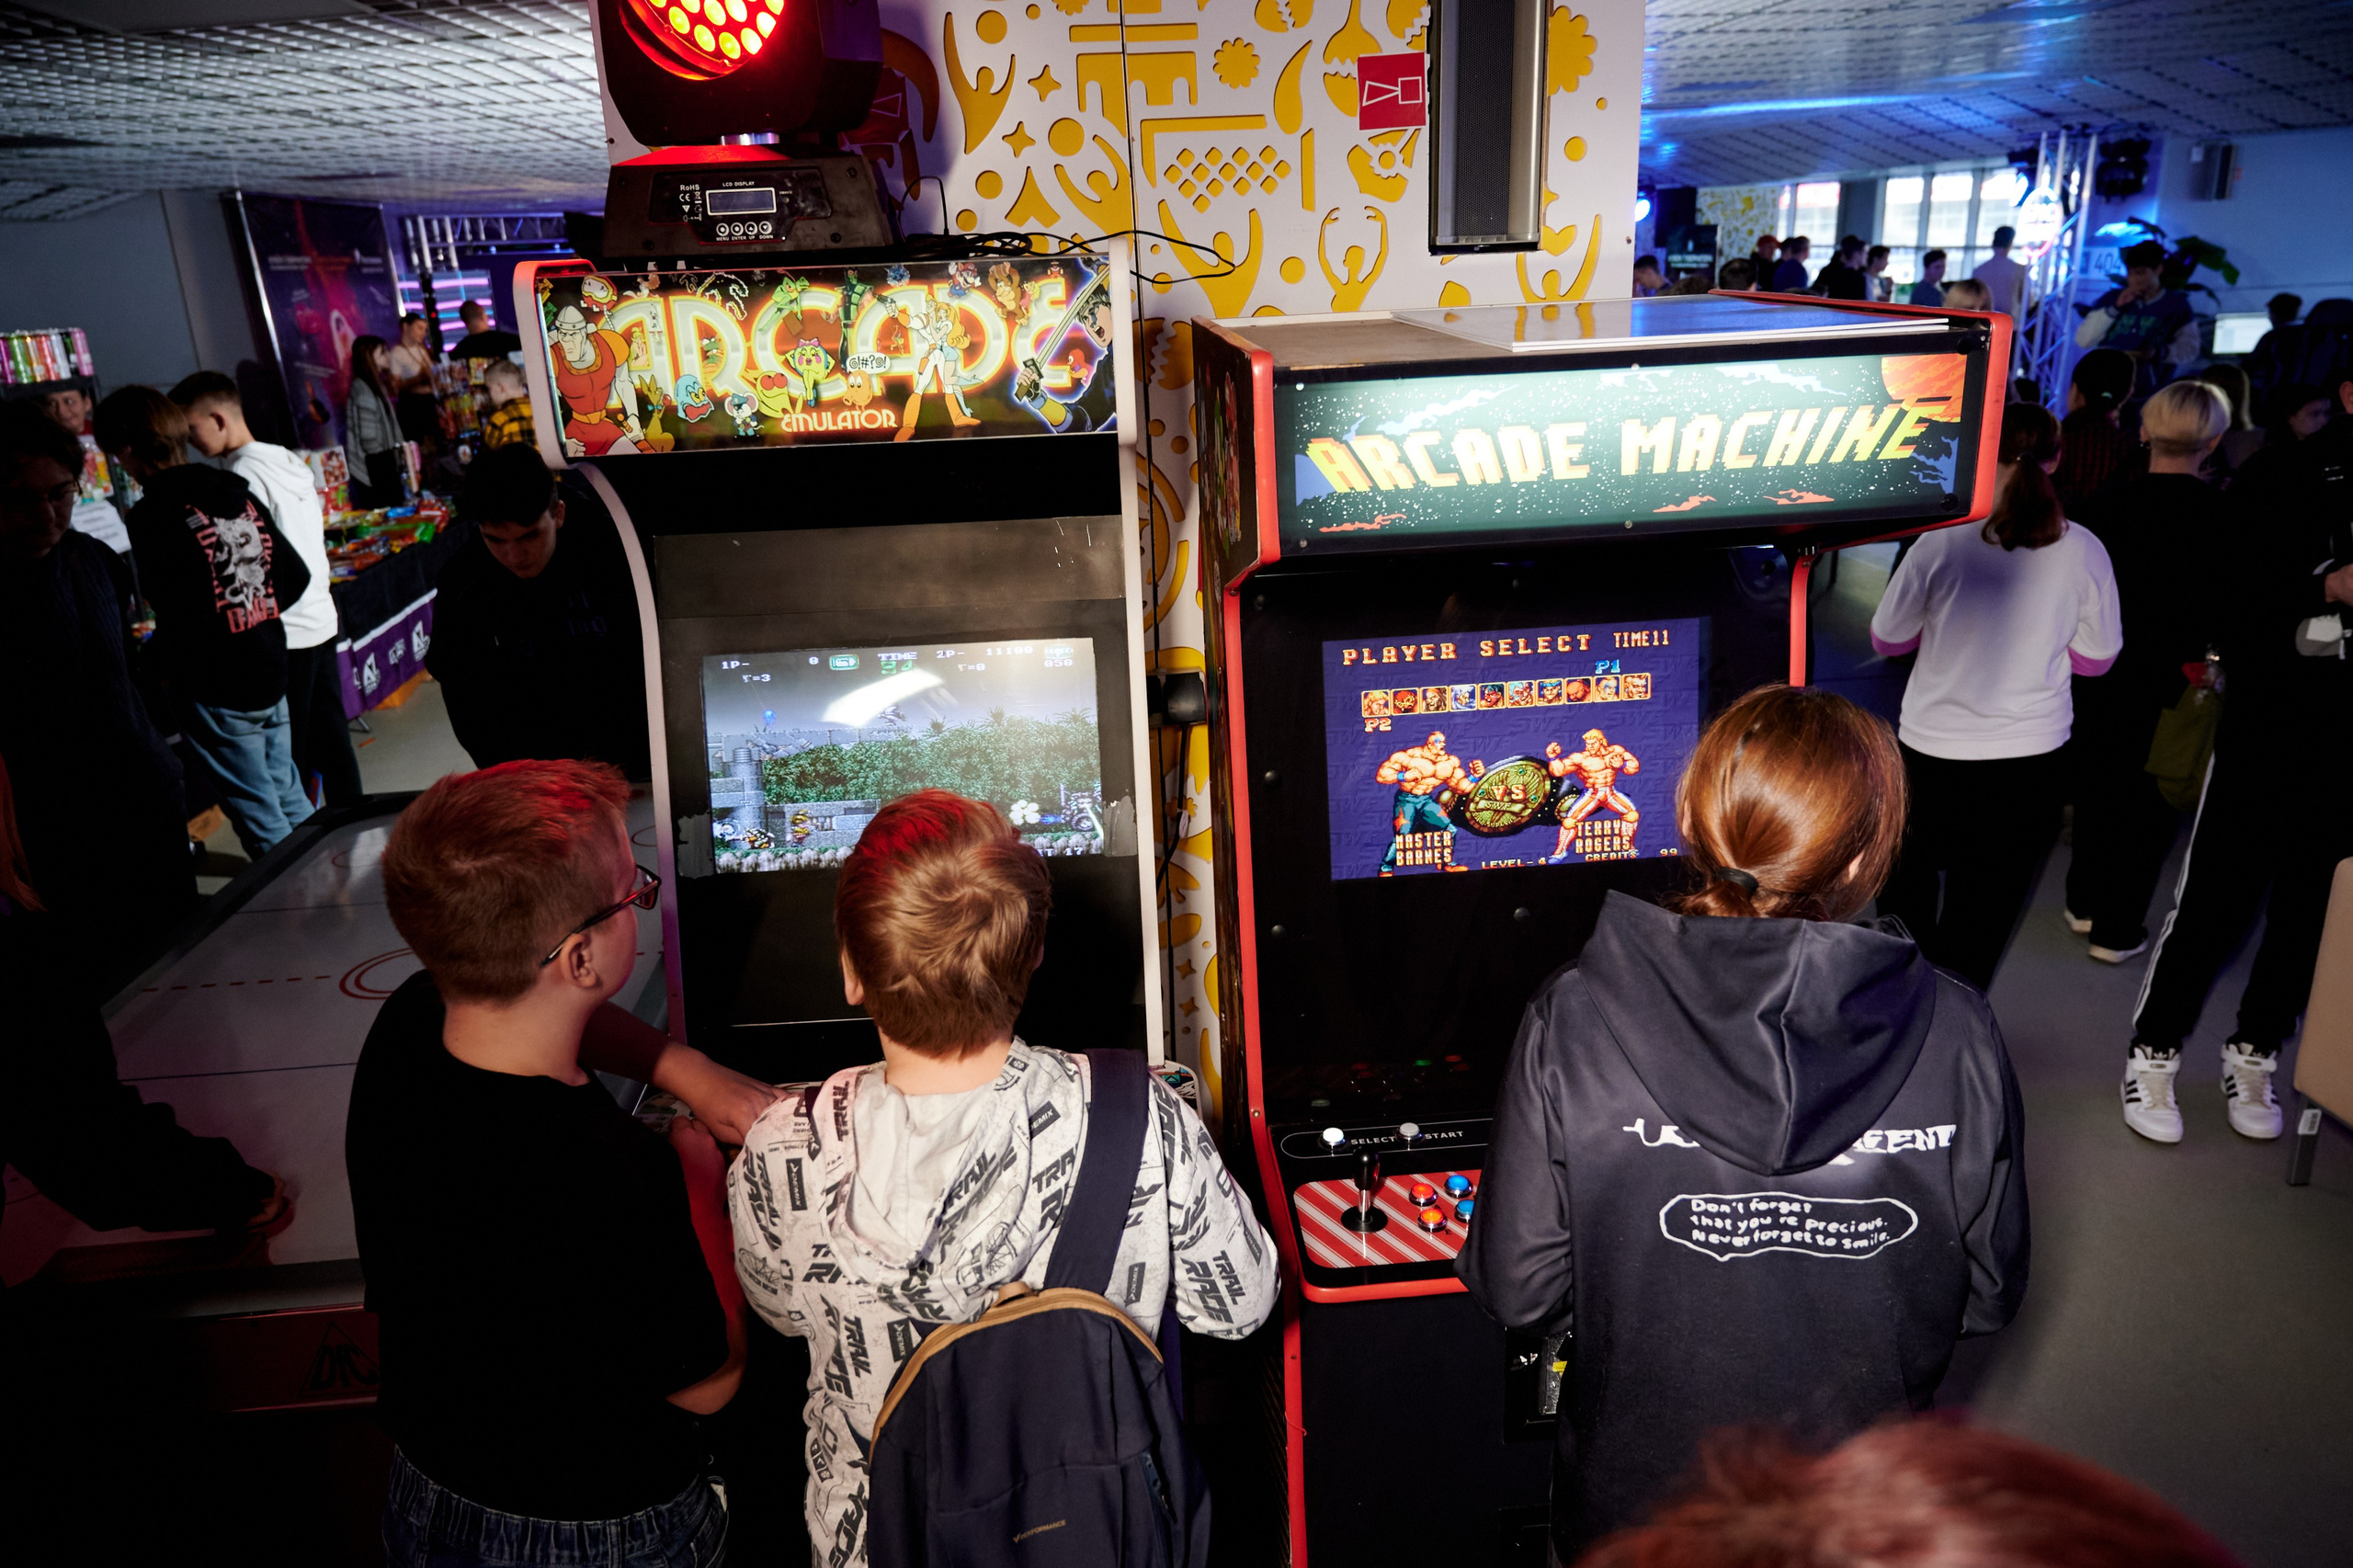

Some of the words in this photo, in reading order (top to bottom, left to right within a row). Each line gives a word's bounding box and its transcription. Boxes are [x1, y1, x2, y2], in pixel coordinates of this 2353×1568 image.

[596, 277, 1072, 410] ARCADE
[780, 409, 898, 434] EMULATOR
[1306, 421, 1591, 494] ARCADE
[1620, 395, 1954, 477] MACHINE
[877, 652, 918, 662] TIME
[1342, 642, 1457, 666] PLAYER
[1480, 633, 1592, 658] SELECT
[1595, 659, 1621, 675] P1
[1364, 718, 1392, 733] P2
[1492, 784, 1526, 801] VS
[1575, 821, 1621, 838] TERRY
[1395, 830, 1453, 850] MASTER
[1575, 835, 1632, 855] ROGERS
[1065, 846, 1085, 856] 17
[1395, 847, 1453, 868] BARNES
[1585, 851, 1637, 862] CREDITS
[1660, 848, 1678, 858] 99
[1538, 857, 1547, 866] 4
[1350, 1135, 1396, 1145] SELECT
[1424, 1131, 1464, 1141] START
[1690, 1199, 1744, 1214] Don't
[1691, 1229, 1751, 1247] Never
[1753, 1229, 1813, 1244] forget
[1814, 1234, 1837, 1247] to
[1212, 1250, 1246, 1305] TRAIL
[1180, 1256, 1234, 1324] RACE
[843, 1314, 872, 1378] TRAIL
[1019, 1518, 1067, 1541] PERFORMANCE
